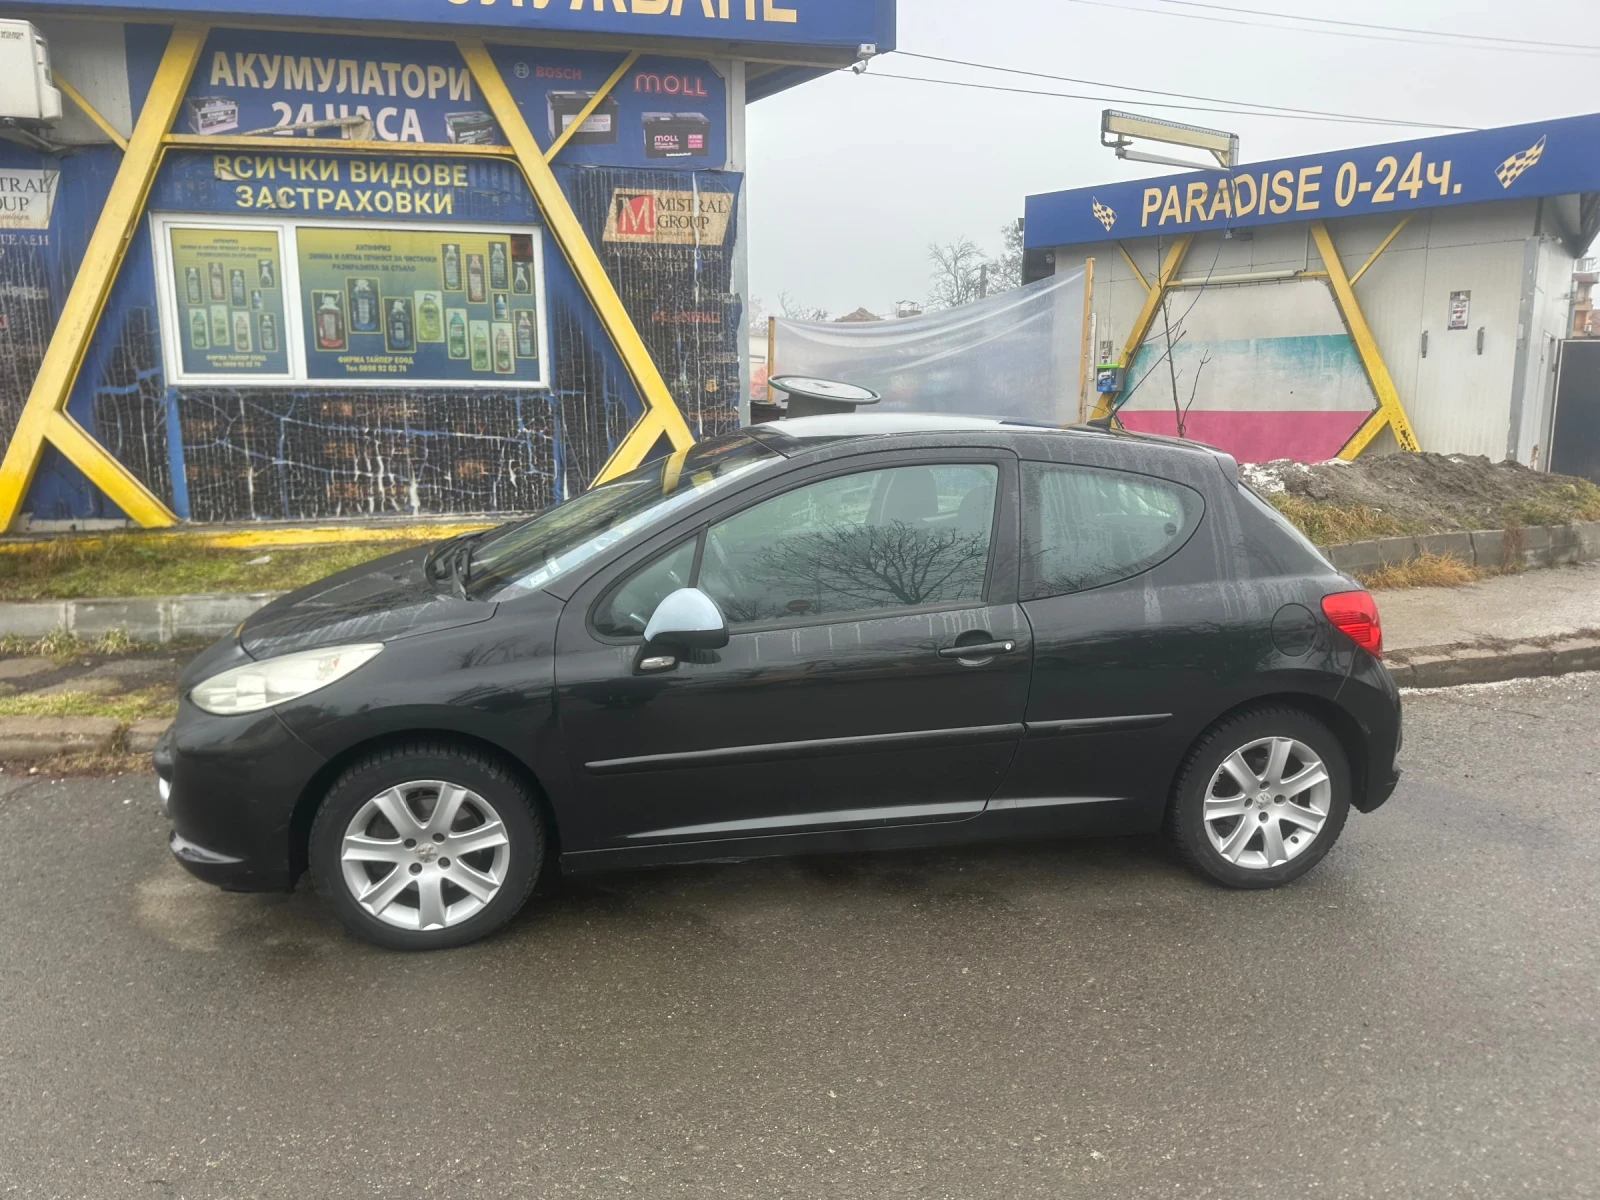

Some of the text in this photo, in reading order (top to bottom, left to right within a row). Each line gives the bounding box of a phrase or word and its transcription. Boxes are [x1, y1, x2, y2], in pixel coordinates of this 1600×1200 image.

[209, 51, 472, 102] АКУМУЛАТОРИ
[536, 66, 582, 80] BOSCH
[271, 101, 315, 137] 24
[213, 154, 468, 189] ВСИЧКИ ВИДОВЕ
[0, 196, 29, 212] UP
[235, 184, 453, 215] ЗАСТРАХОВКИ
[1141, 165, 1323, 228] PARADISE
[657, 214, 710, 230] GROUP
